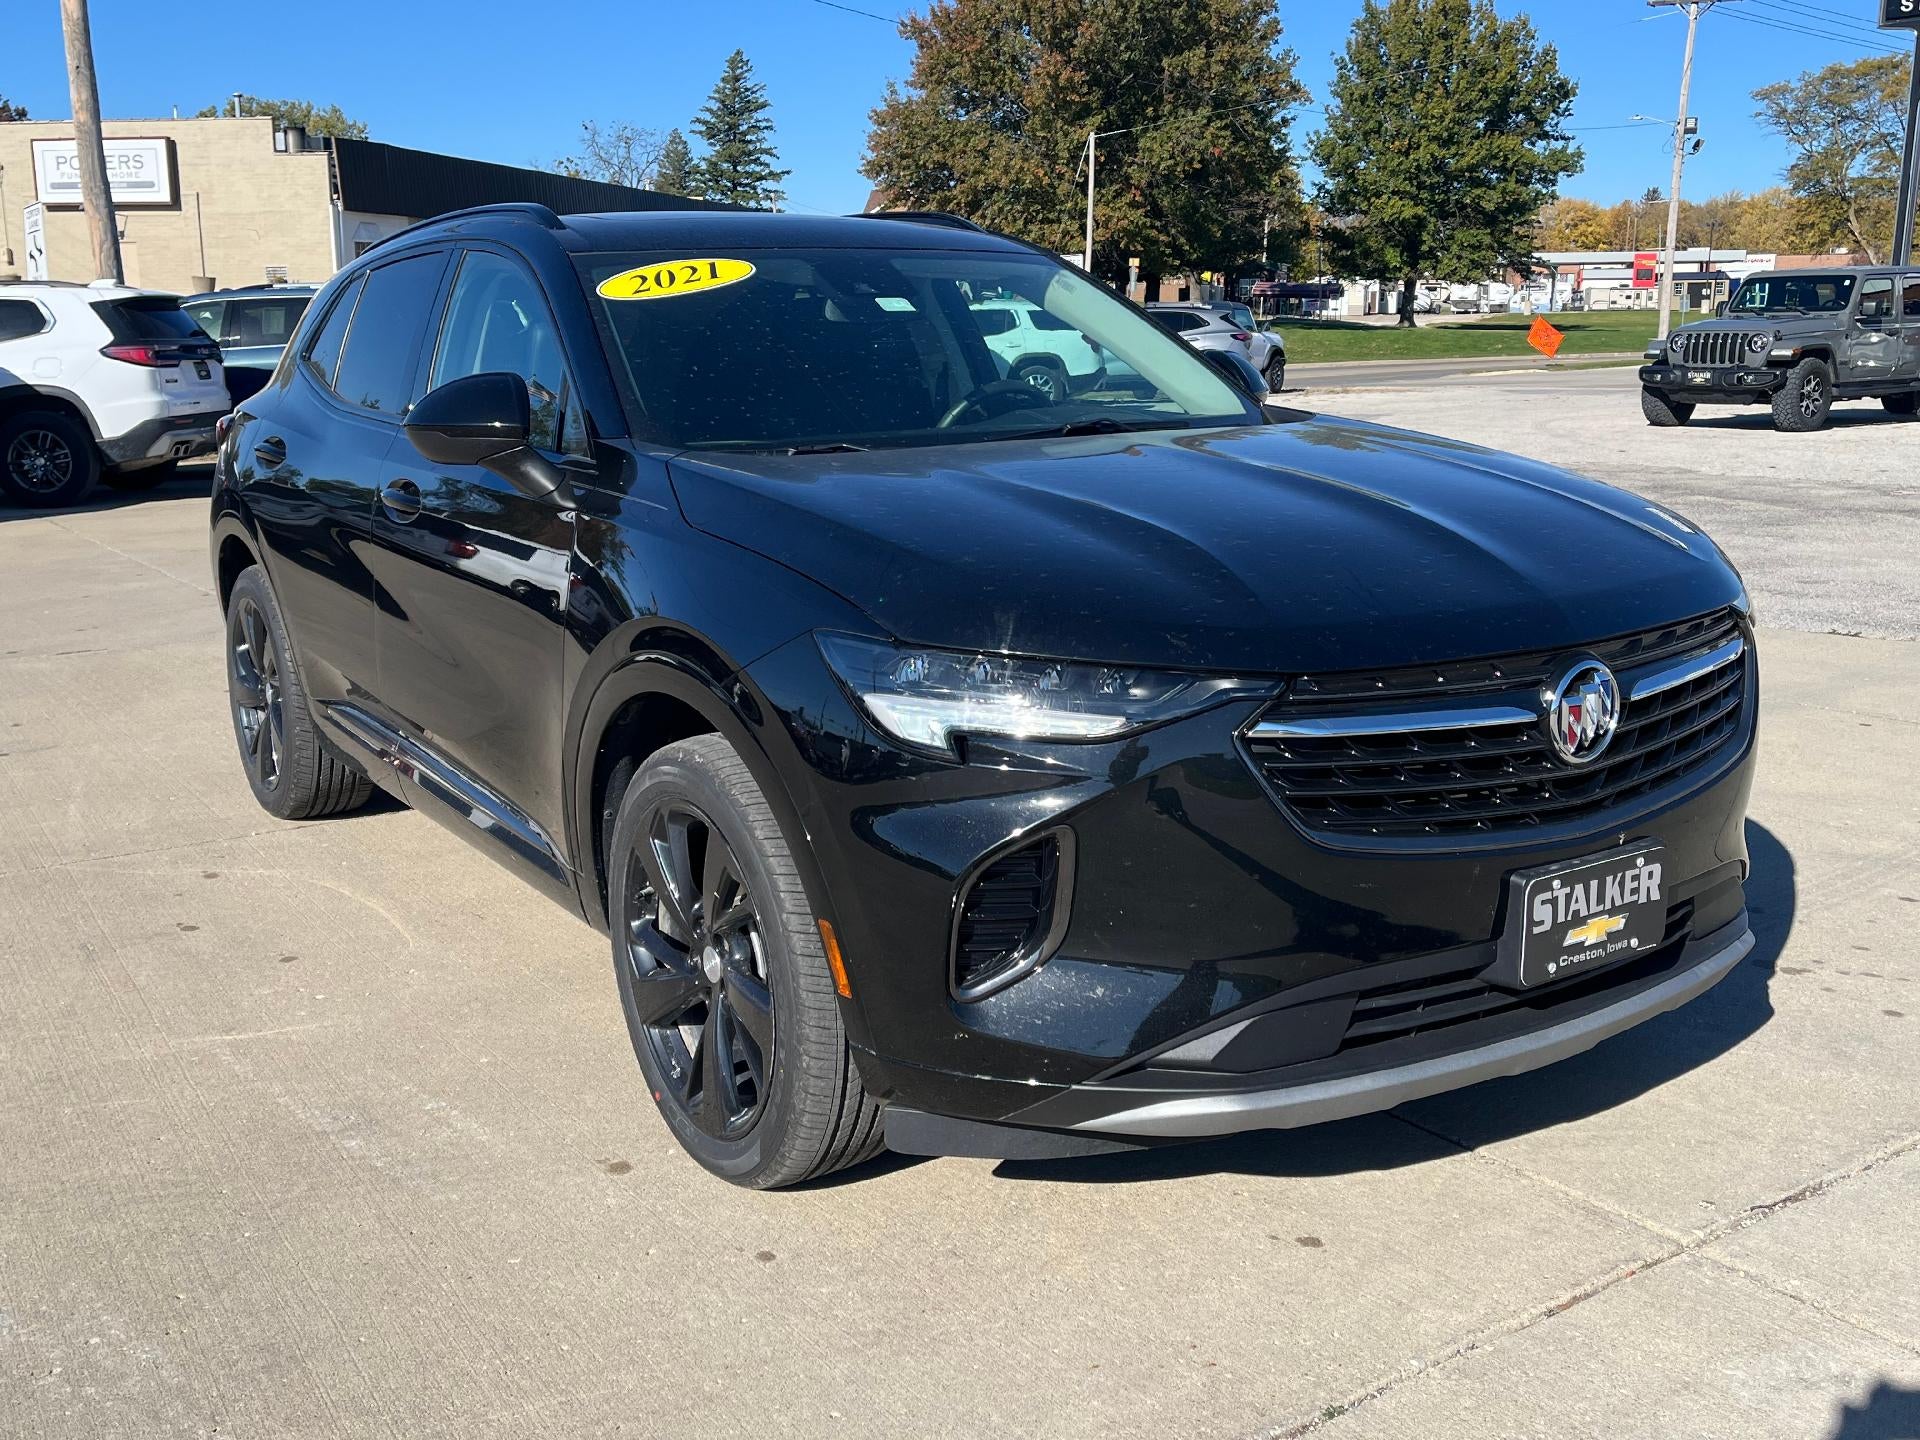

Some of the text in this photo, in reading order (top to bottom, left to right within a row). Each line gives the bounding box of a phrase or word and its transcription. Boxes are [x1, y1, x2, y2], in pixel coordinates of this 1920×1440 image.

[55, 154, 144, 171] POERS
[111, 171, 141, 179] HOME
[629, 261, 722, 295] 2021
[1533, 863, 1662, 934] STALKER
[1559, 938, 1629, 967] Creston, Iowa
